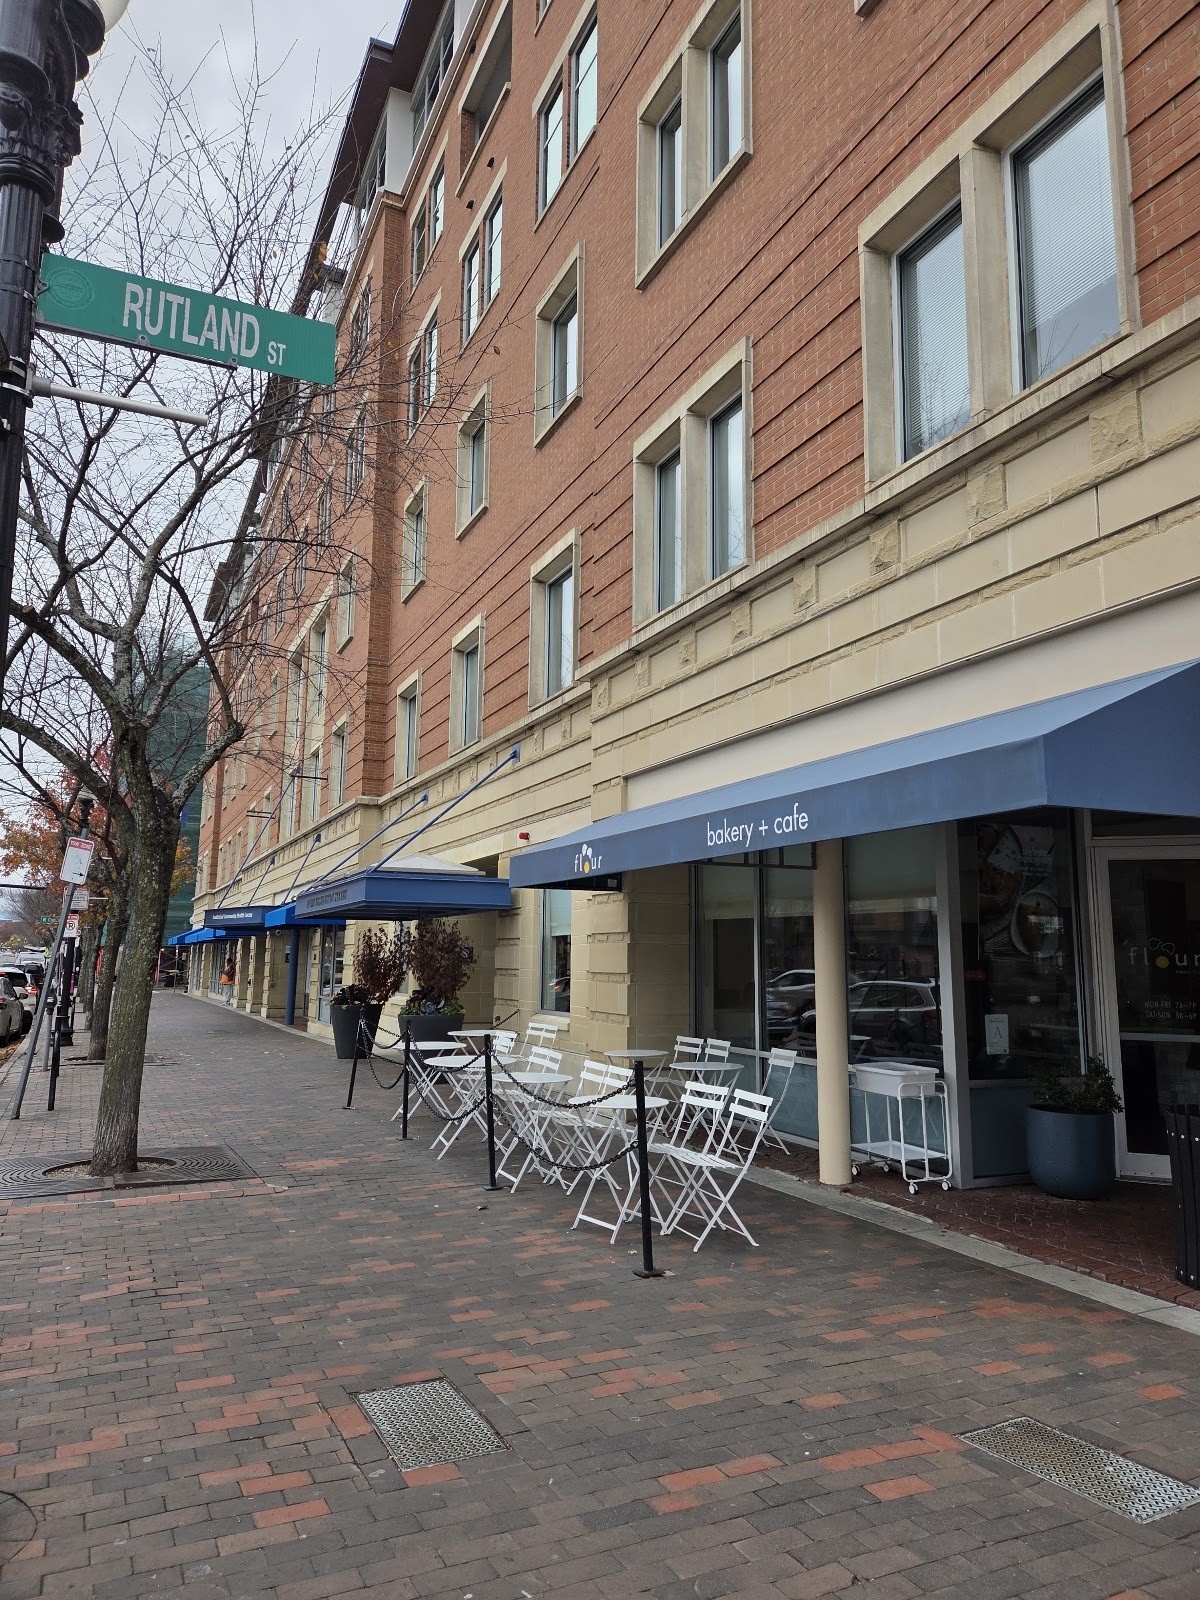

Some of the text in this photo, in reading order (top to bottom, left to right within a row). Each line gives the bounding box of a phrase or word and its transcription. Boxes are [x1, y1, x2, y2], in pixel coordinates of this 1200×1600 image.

[122, 281, 260, 358] RUTLAND
[267, 341, 287, 366] ST
[707, 802, 809, 848] bakery + cafe
[574, 852, 603, 874] flour
